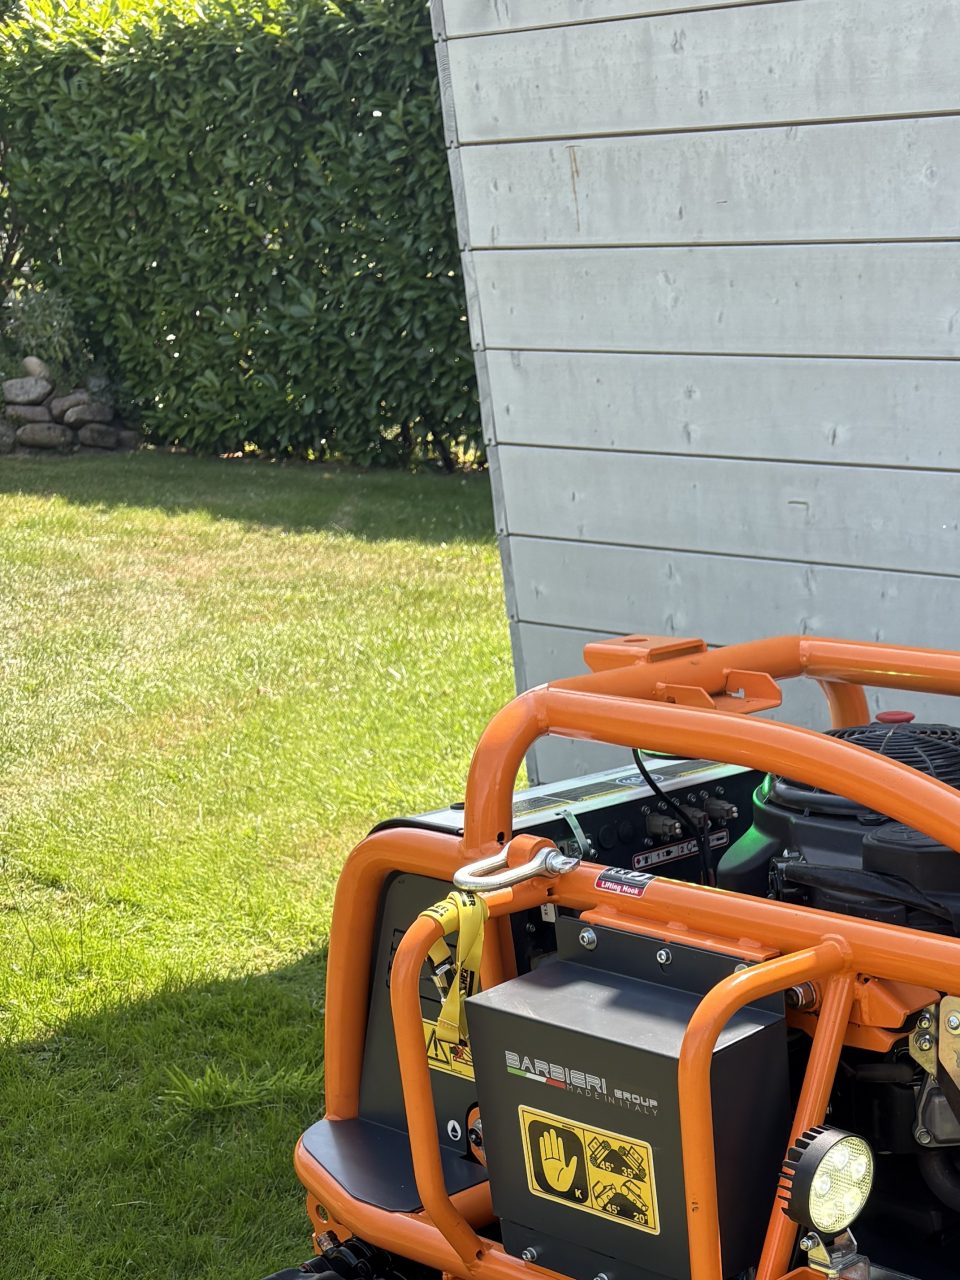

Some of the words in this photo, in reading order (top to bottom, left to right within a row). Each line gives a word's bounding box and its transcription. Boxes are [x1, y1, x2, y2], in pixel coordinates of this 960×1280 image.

[601, 880, 622, 892] Lifting
[622, 885, 639, 895] Hook
[505, 1050, 607, 1094] BARBIERI
[614, 1088, 658, 1108] GROUP
[566, 1084, 600, 1100] MADE
[620, 1100, 658, 1116] ITALY
[574, 1188, 583, 1199] K
